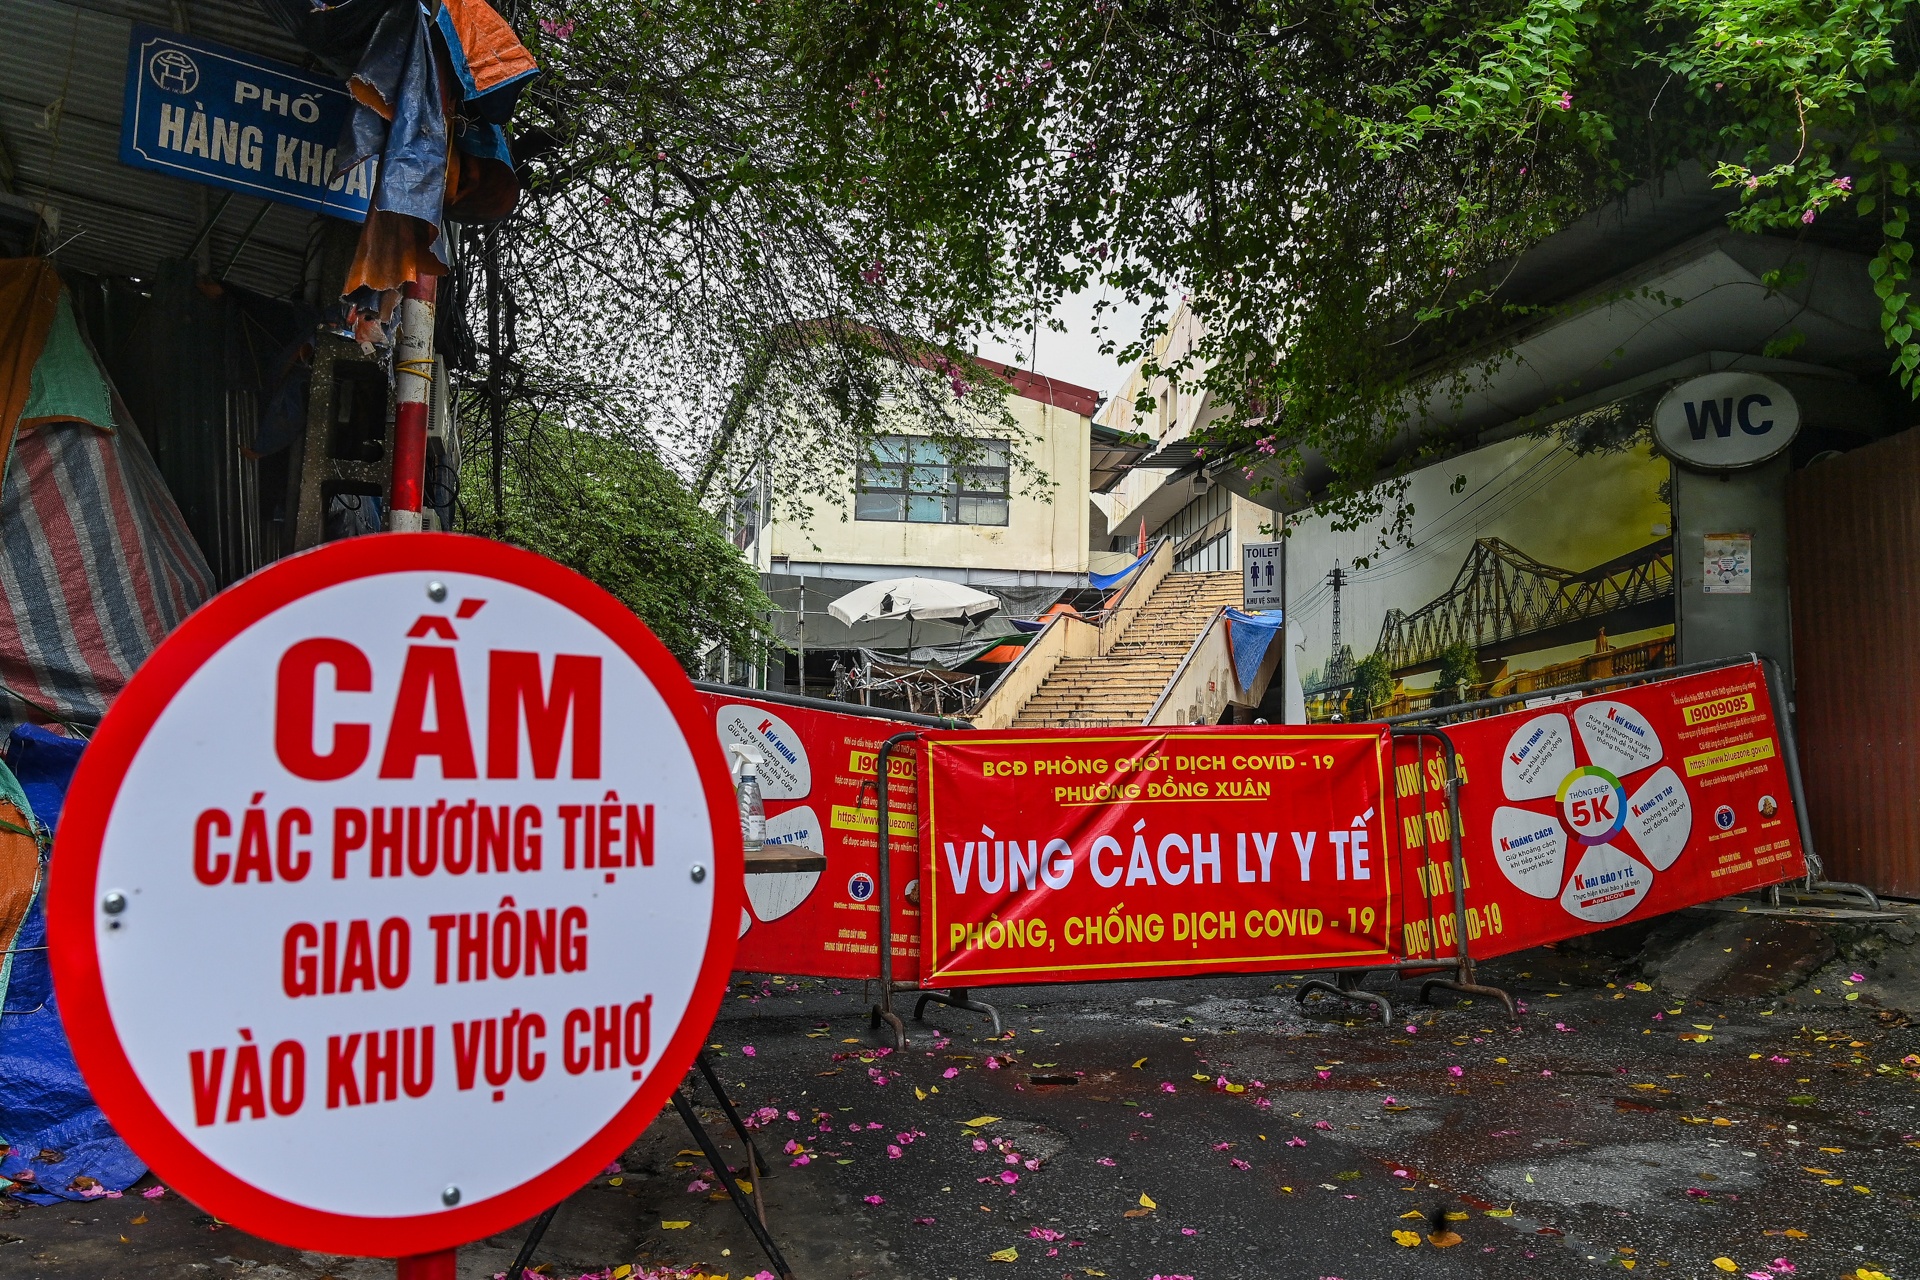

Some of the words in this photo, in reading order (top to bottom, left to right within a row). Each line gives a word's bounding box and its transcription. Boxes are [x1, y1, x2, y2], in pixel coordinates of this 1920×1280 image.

[234, 80, 323, 123] PHỐ
[158, 101, 263, 172] HÀNG
[1684, 394, 1774, 440] WC
[1246, 547, 1279, 558] TOILET
[1259, 596, 1265, 605] VỆ
[274, 598, 603, 781] CẤM
[1690, 697, 1748, 722] 19009095
[1527, 728, 1544, 747] TRANG
[1603, 722, 1611, 731] tay
[1597, 736, 1613, 749] thông
[1606, 732, 1618, 742] sinh
[1627, 744, 1637, 753] nhà
[747, 732, 758, 743] tay
[780, 765, 798, 783] xuyên
[983, 761, 1027, 776] BCĐ
[1034, 755, 1108, 775] PHÒNG
[1114, 750, 1169, 772] CHỐT
[1175, 755, 1225, 774] DỊCH
[1232, 755, 1295, 770] COVID
[1312, 755, 1335, 769] 19
[1519, 768, 1530, 780] Đeo
[1538, 739, 1551, 755] trang
[1540, 751, 1552, 766] công
[769, 767, 780, 779] nhà
[1054, 781, 1140, 802] PHƯỜNG
[1148, 775, 1208, 798] ĐỒNG
[1215, 777, 1270, 797] XUÂN
[1569, 788, 1593, 799] THÔNG
[1594, 785, 1609, 794] ĐIỆP
[1572, 795, 1614, 826] 5K
[1632, 799, 1656, 817] KHÔNG
[1642, 810, 1662, 826] Không
[1404, 815, 1424, 849] AN
[1534, 827, 1554, 840] CÁCH
[1653, 817, 1668, 829] đông
[193, 791, 312, 885] CÁC
[333, 799, 543, 879] PHƯƠNG
[559, 790, 655, 883] TIỆN
[1542, 840, 1557, 849] cách
[943, 824, 1074, 894] VÙNG
[1089, 817, 1221, 888] CÁCH
[1237, 832, 1278, 883] LY
[1290, 832, 1317, 881] Y
[1329, 806, 1374, 881] TẾ
[1510, 861, 1520, 869] khi
[1539, 859, 1553, 867] khác
[1574, 874, 1598, 891] KHAI
[1600, 872, 1616, 884] BÁO
[1618, 871, 1622, 879] Y
[950, 912, 1055, 952] PHÒNG,
[1064, 902, 1165, 946] CHỐNG
[1173, 910, 1236, 949] DỊCH
[1244, 908, 1323, 938] COVID
[1348, 906, 1375, 934] 19
[1440, 902, 1502, 946] COID-19
[282, 916, 412, 999] GIAO
[429, 895, 588, 984] THÔNG
[188, 1028, 306, 1128] VÀO
[326, 1025, 435, 1110] KHU
[452, 1008, 547, 1103] VỰC
[562, 994, 653, 1081] CHỢ
